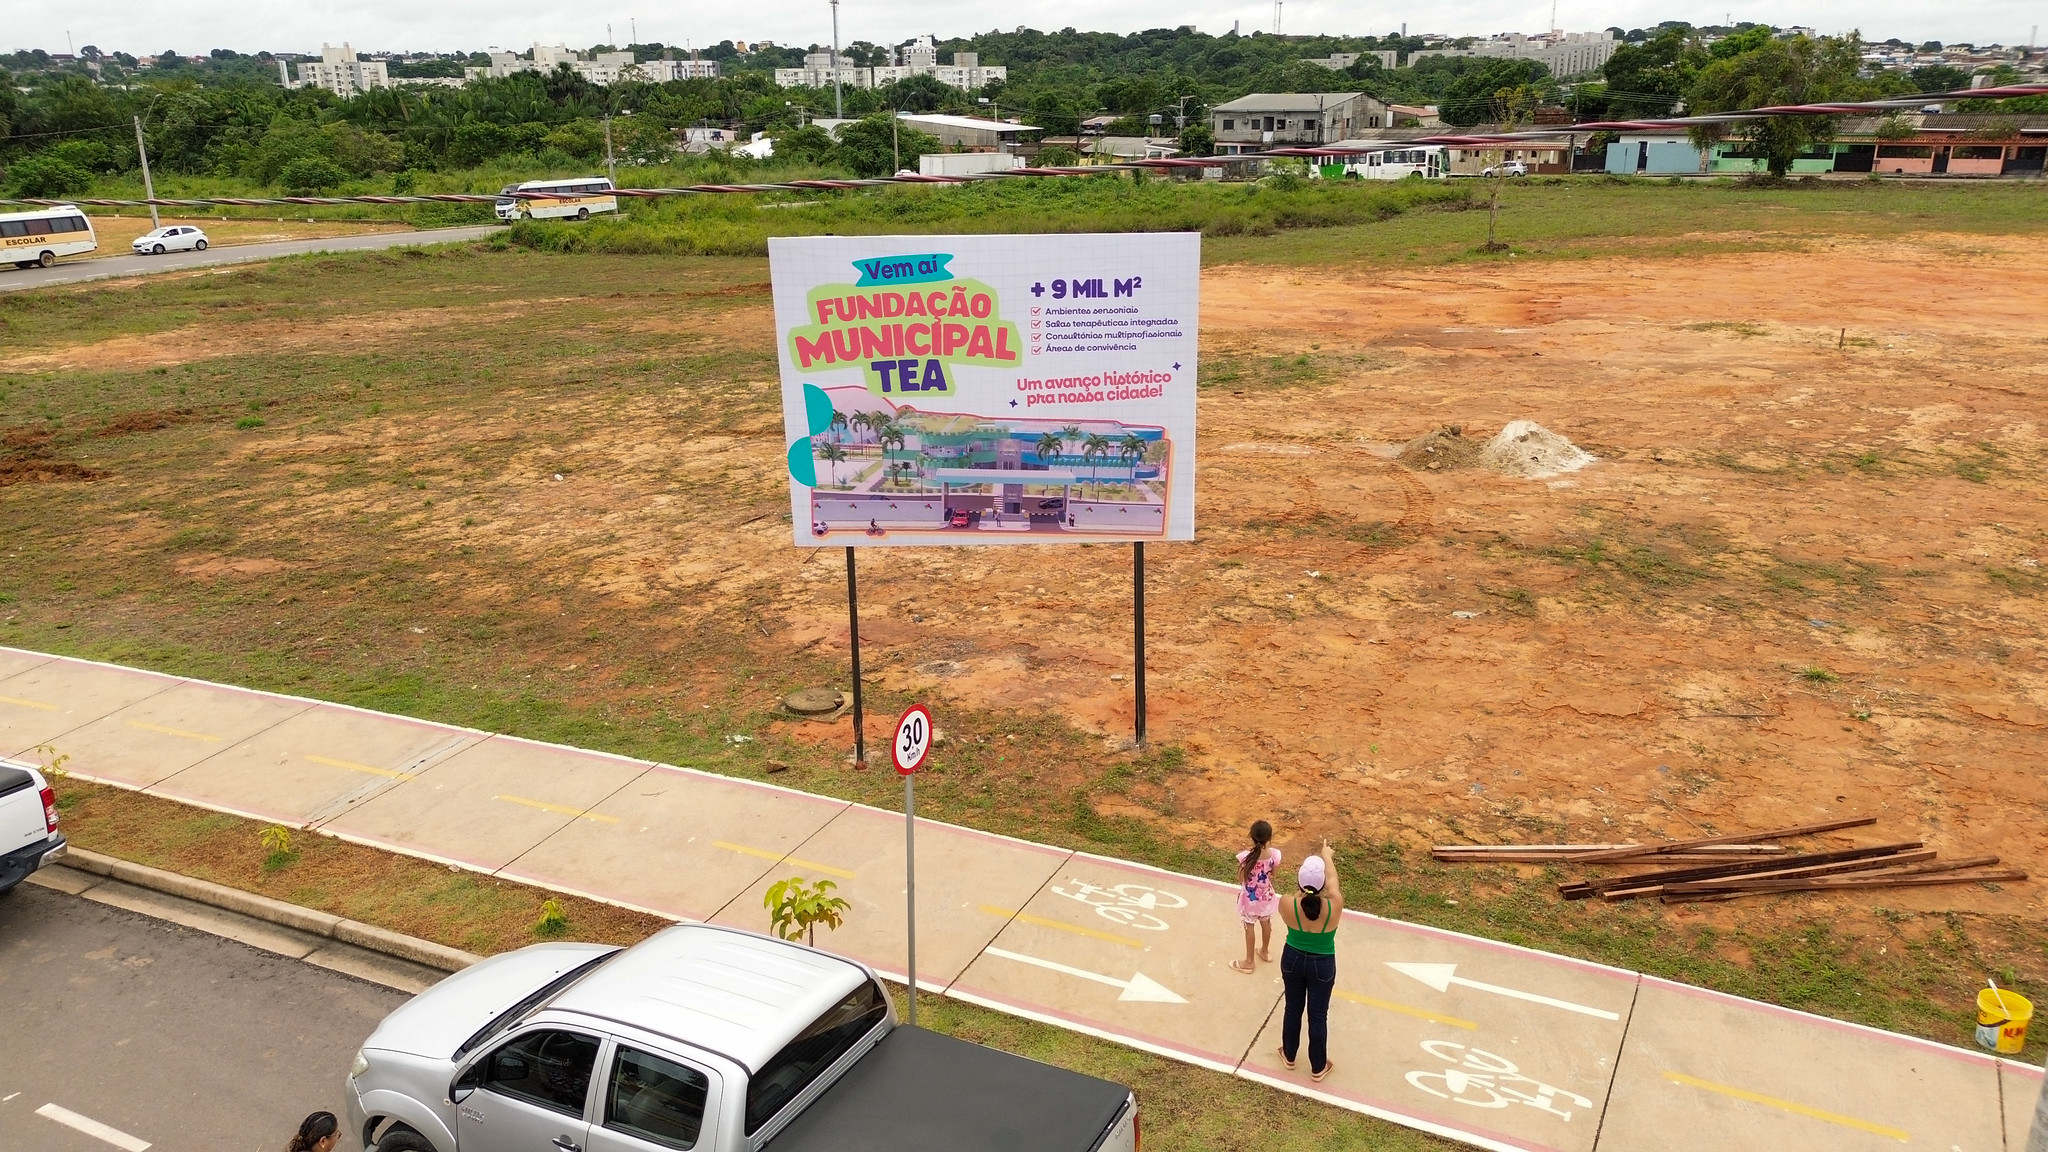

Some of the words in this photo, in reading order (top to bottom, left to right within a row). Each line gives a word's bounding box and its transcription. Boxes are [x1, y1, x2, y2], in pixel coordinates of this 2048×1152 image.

[6, 237, 46, 246] ESCOLAR
[864, 261, 914, 280] Vem
[918, 255, 938, 274] aí
[1051, 279, 1067, 299] 9
[1072, 279, 1108, 298] MIL
[816, 286, 992, 325] FUNDAÇÃO
[1045, 307, 1091, 316] Ambientes
[1092, 305, 1139, 315] sensoriais
[1045, 320, 1071, 328] Salas
[1072, 319, 1128, 329] terapêuticas
[1130, 317, 1179, 328] integradas
[795, 322, 1017, 368] MUNICIPAL
[1045, 331, 1103, 341] Consultórios
[1104, 329, 1183, 340] multiprofissionais
[1045, 343, 1073, 353] Áreas
[1074, 344, 1085, 352] de
[1086, 343, 1137, 352] convivência
[871, 359, 948, 393] TEA
[1016, 378, 1043, 391] Um
[1044, 375, 1101, 392] avanço
[1103, 369, 1172, 387] histórico
[1027, 393, 1056, 407] pra
[1058, 390, 1104, 404] nossa
[1106, 384, 1163, 401] cidade!
[902, 717, 923, 752] 30
